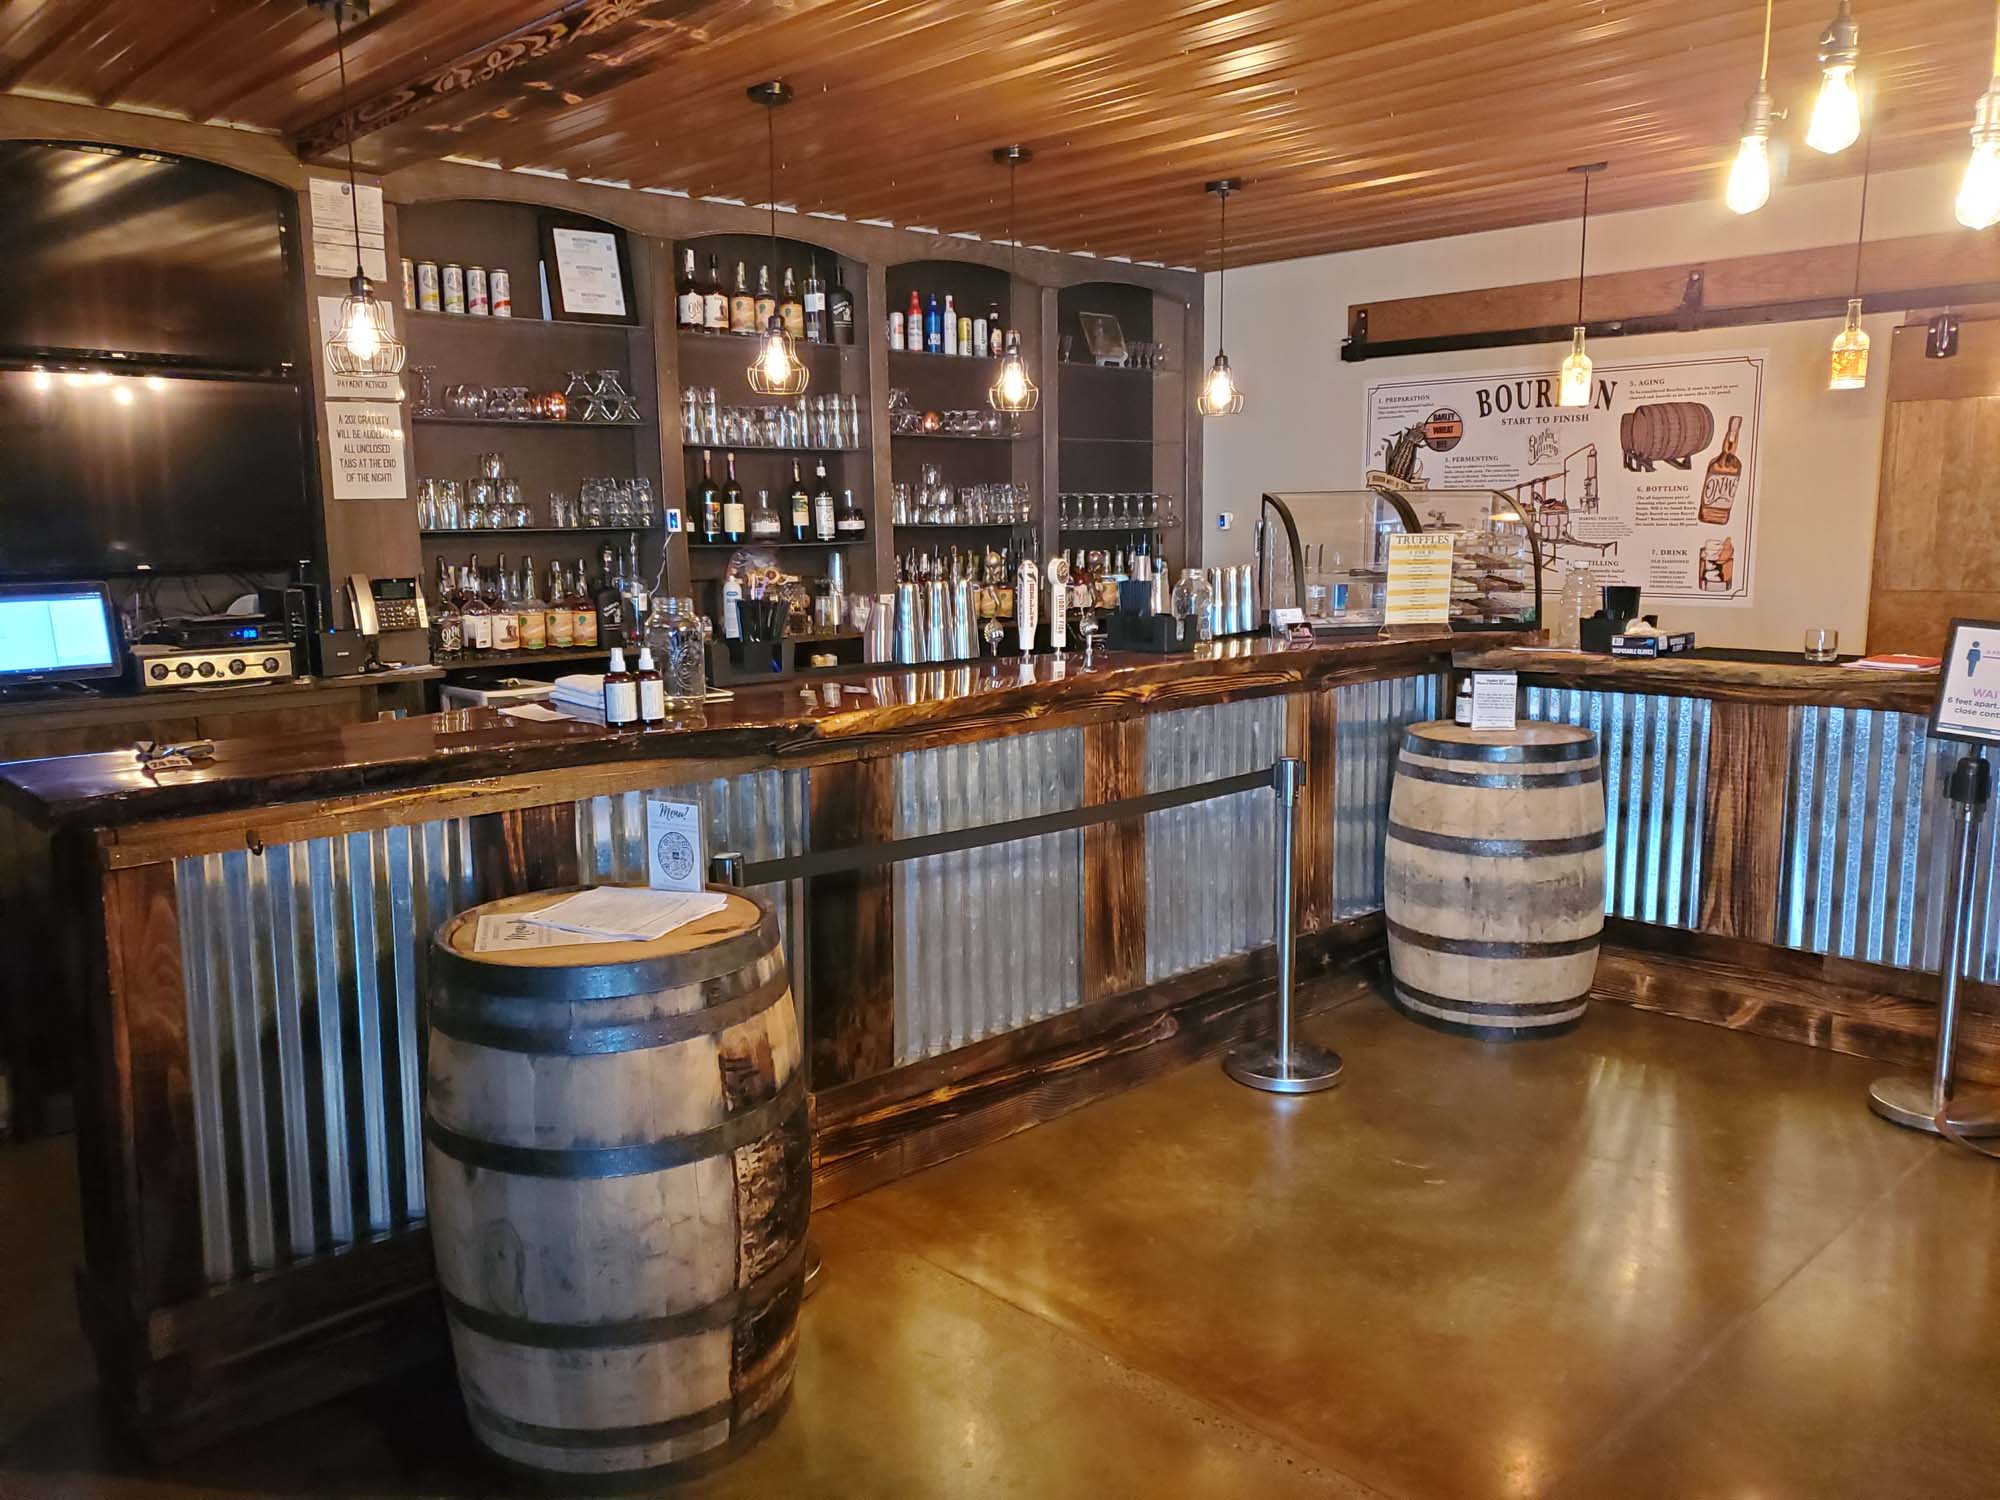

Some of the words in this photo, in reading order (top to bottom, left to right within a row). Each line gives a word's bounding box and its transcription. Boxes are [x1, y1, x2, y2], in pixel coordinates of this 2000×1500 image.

[1386, 394, 1430, 403] PREPARATION
[1476, 379, 1618, 418] BOURN
[338, 415, 342, 424] A
[358, 415, 390, 425] GRATUITY
[1502, 416, 1533, 426] START
[1536, 416, 1550, 424] TO
[1554, 414, 1590, 424] FINISH
[336, 430, 350, 438] WILL
[352, 430, 360, 438] BE
[344, 444, 354, 454] ALL
[356, 444, 390, 454] UNCLOSED
[340, 458, 357, 468] TABS
[358, 458, 366, 468] AT
[368, 458, 381, 468] THE
[384, 458, 396, 468] END
[346, 473, 354, 482] OF
[357, 473, 370, 482] THE
[1396, 535, 1449, 544] TRUFFLES
[1973, 688, 2000, 699] WAI
[1955, 698, 1972, 706] feet
[1954, 708, 1977, 716] close
